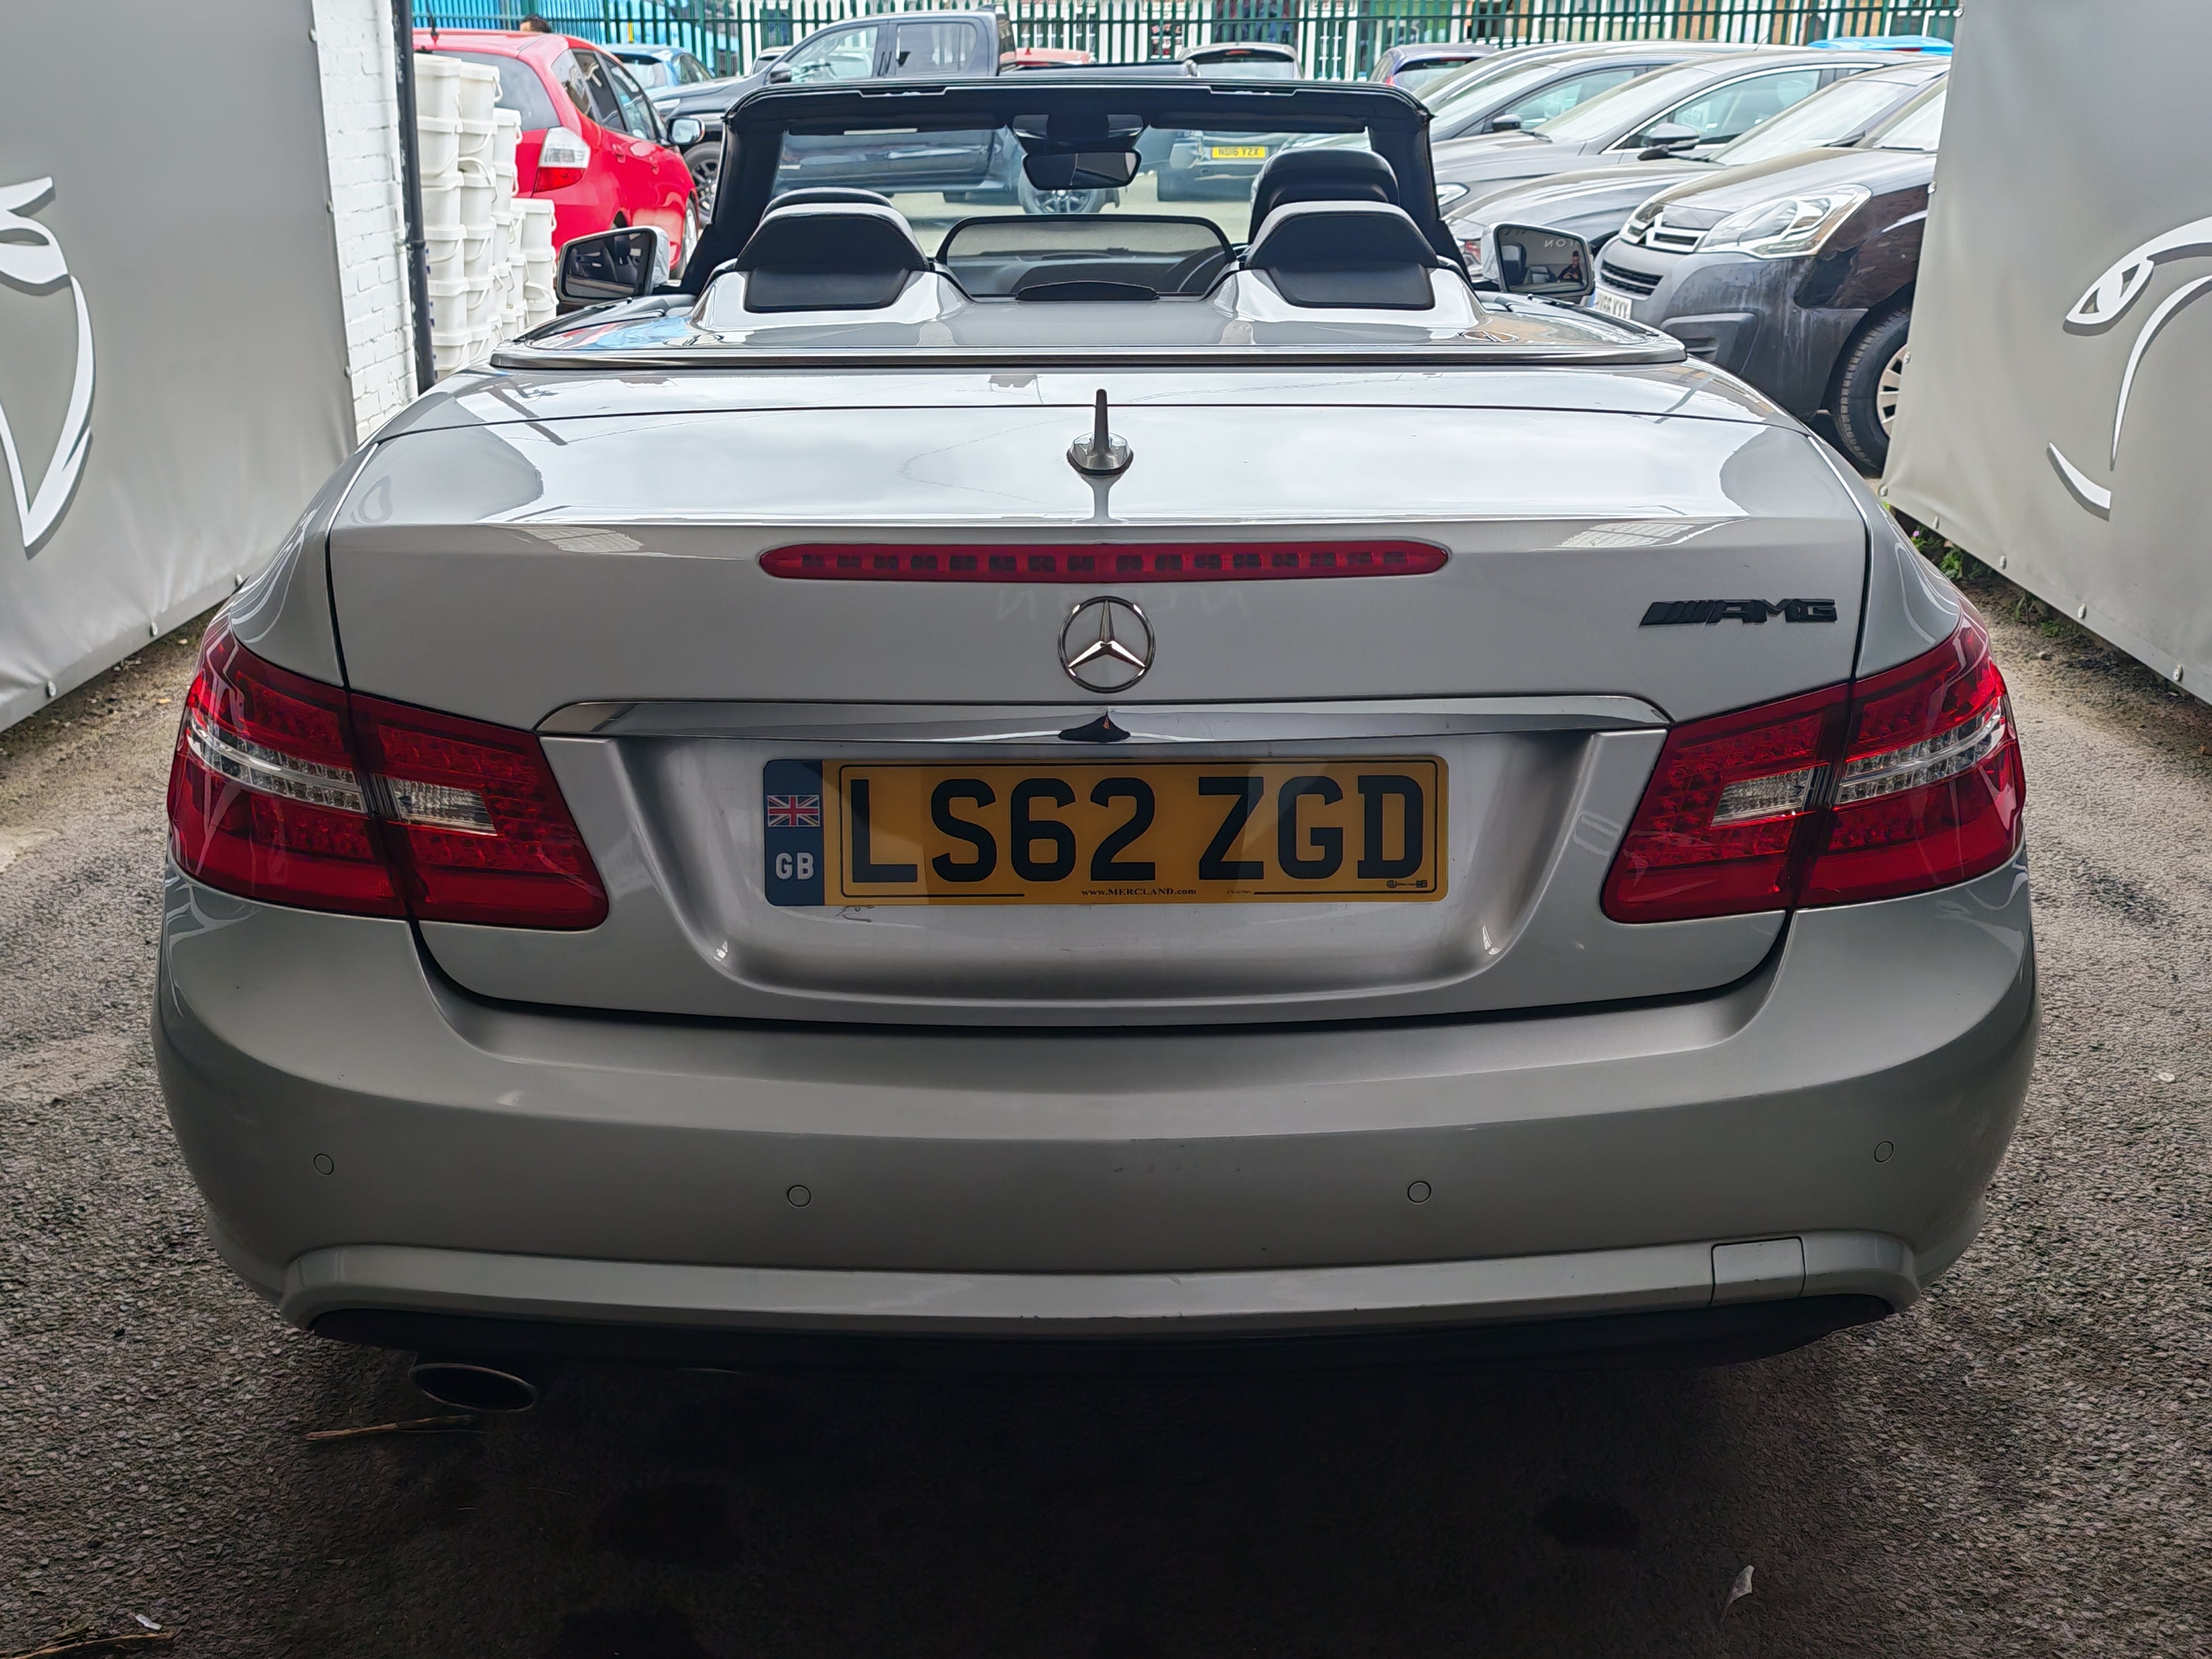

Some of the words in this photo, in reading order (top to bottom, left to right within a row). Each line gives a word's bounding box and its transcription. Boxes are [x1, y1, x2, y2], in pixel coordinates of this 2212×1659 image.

[850, 778, 1156, 883] LS62
[1198, 776, 1424, 881] ZGD
[775, 852, 815, 880] GB
[1081, 888, 1197, 896] www.MERCLAND.com
